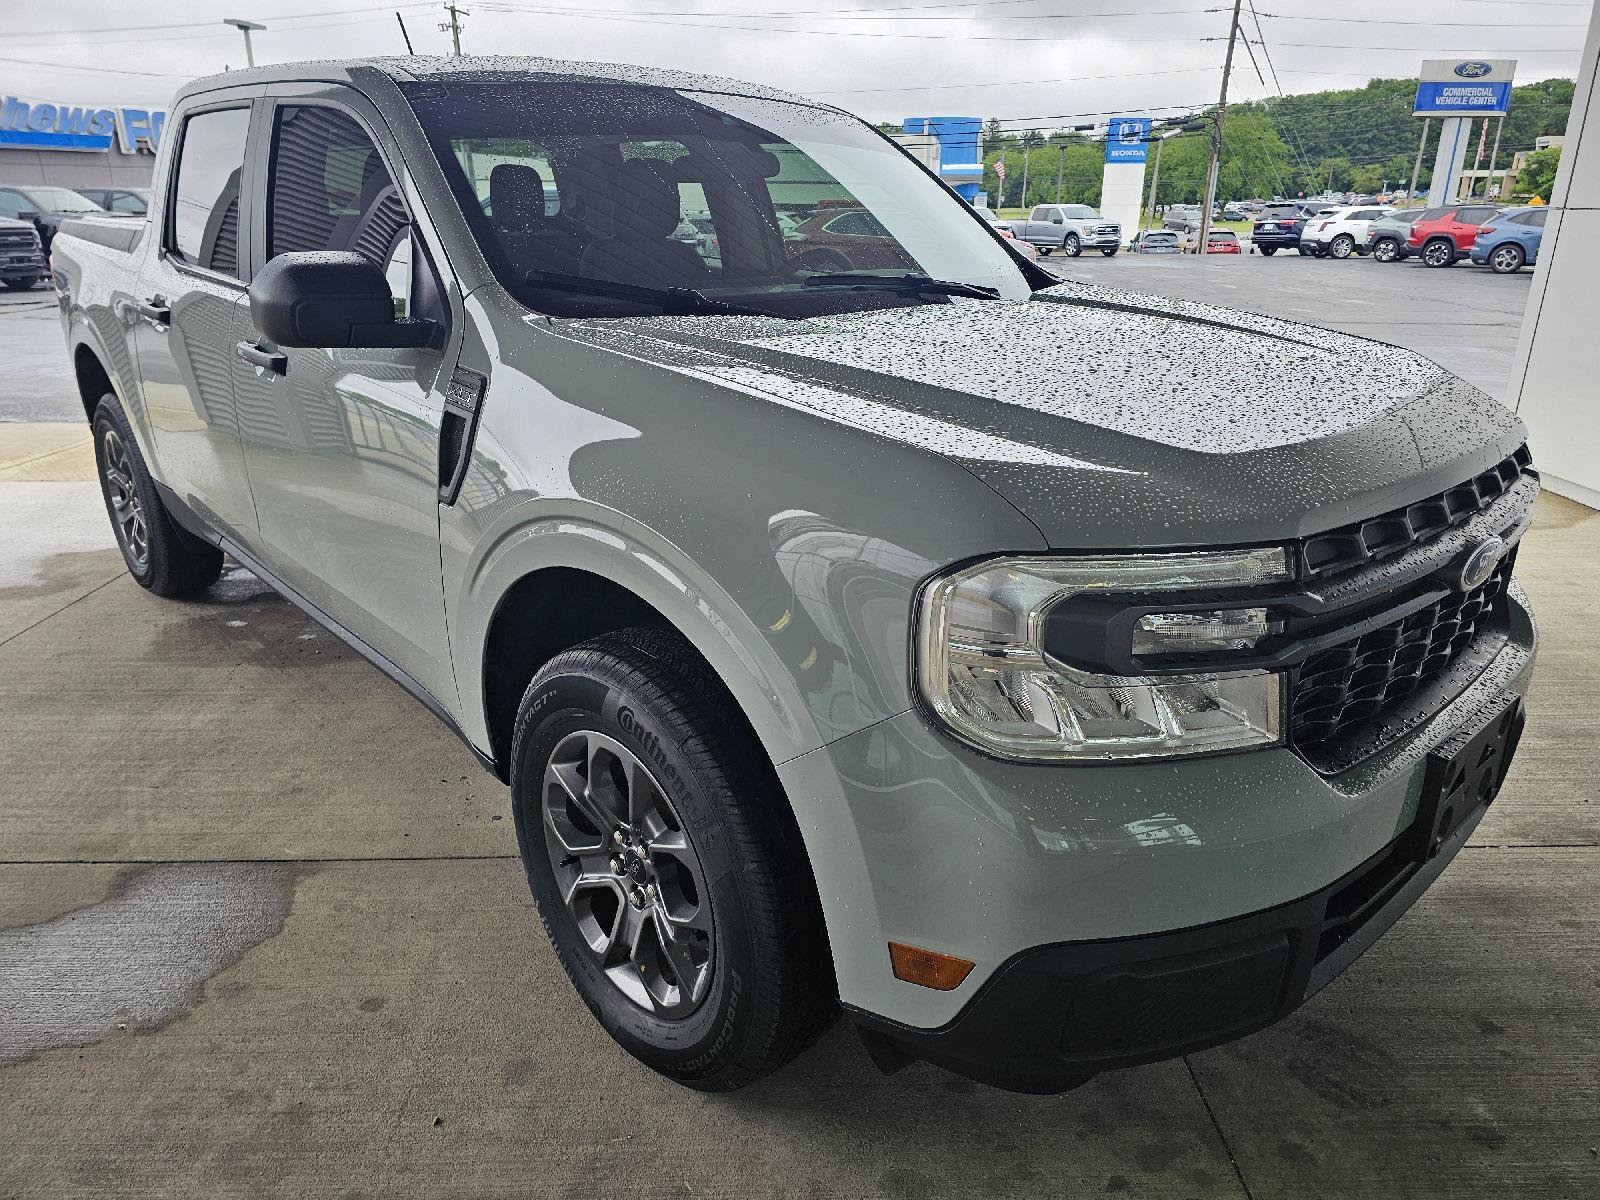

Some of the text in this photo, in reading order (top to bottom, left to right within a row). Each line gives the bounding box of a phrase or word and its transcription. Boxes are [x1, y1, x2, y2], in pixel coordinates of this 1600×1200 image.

[1435, 96, 1497, 105] VEHICLE CENTER
[1443, 87, 1493, 97] COMMERCIAL
[0, 96, 115, 135] hews
[616, 705, 710, 828] Continental
